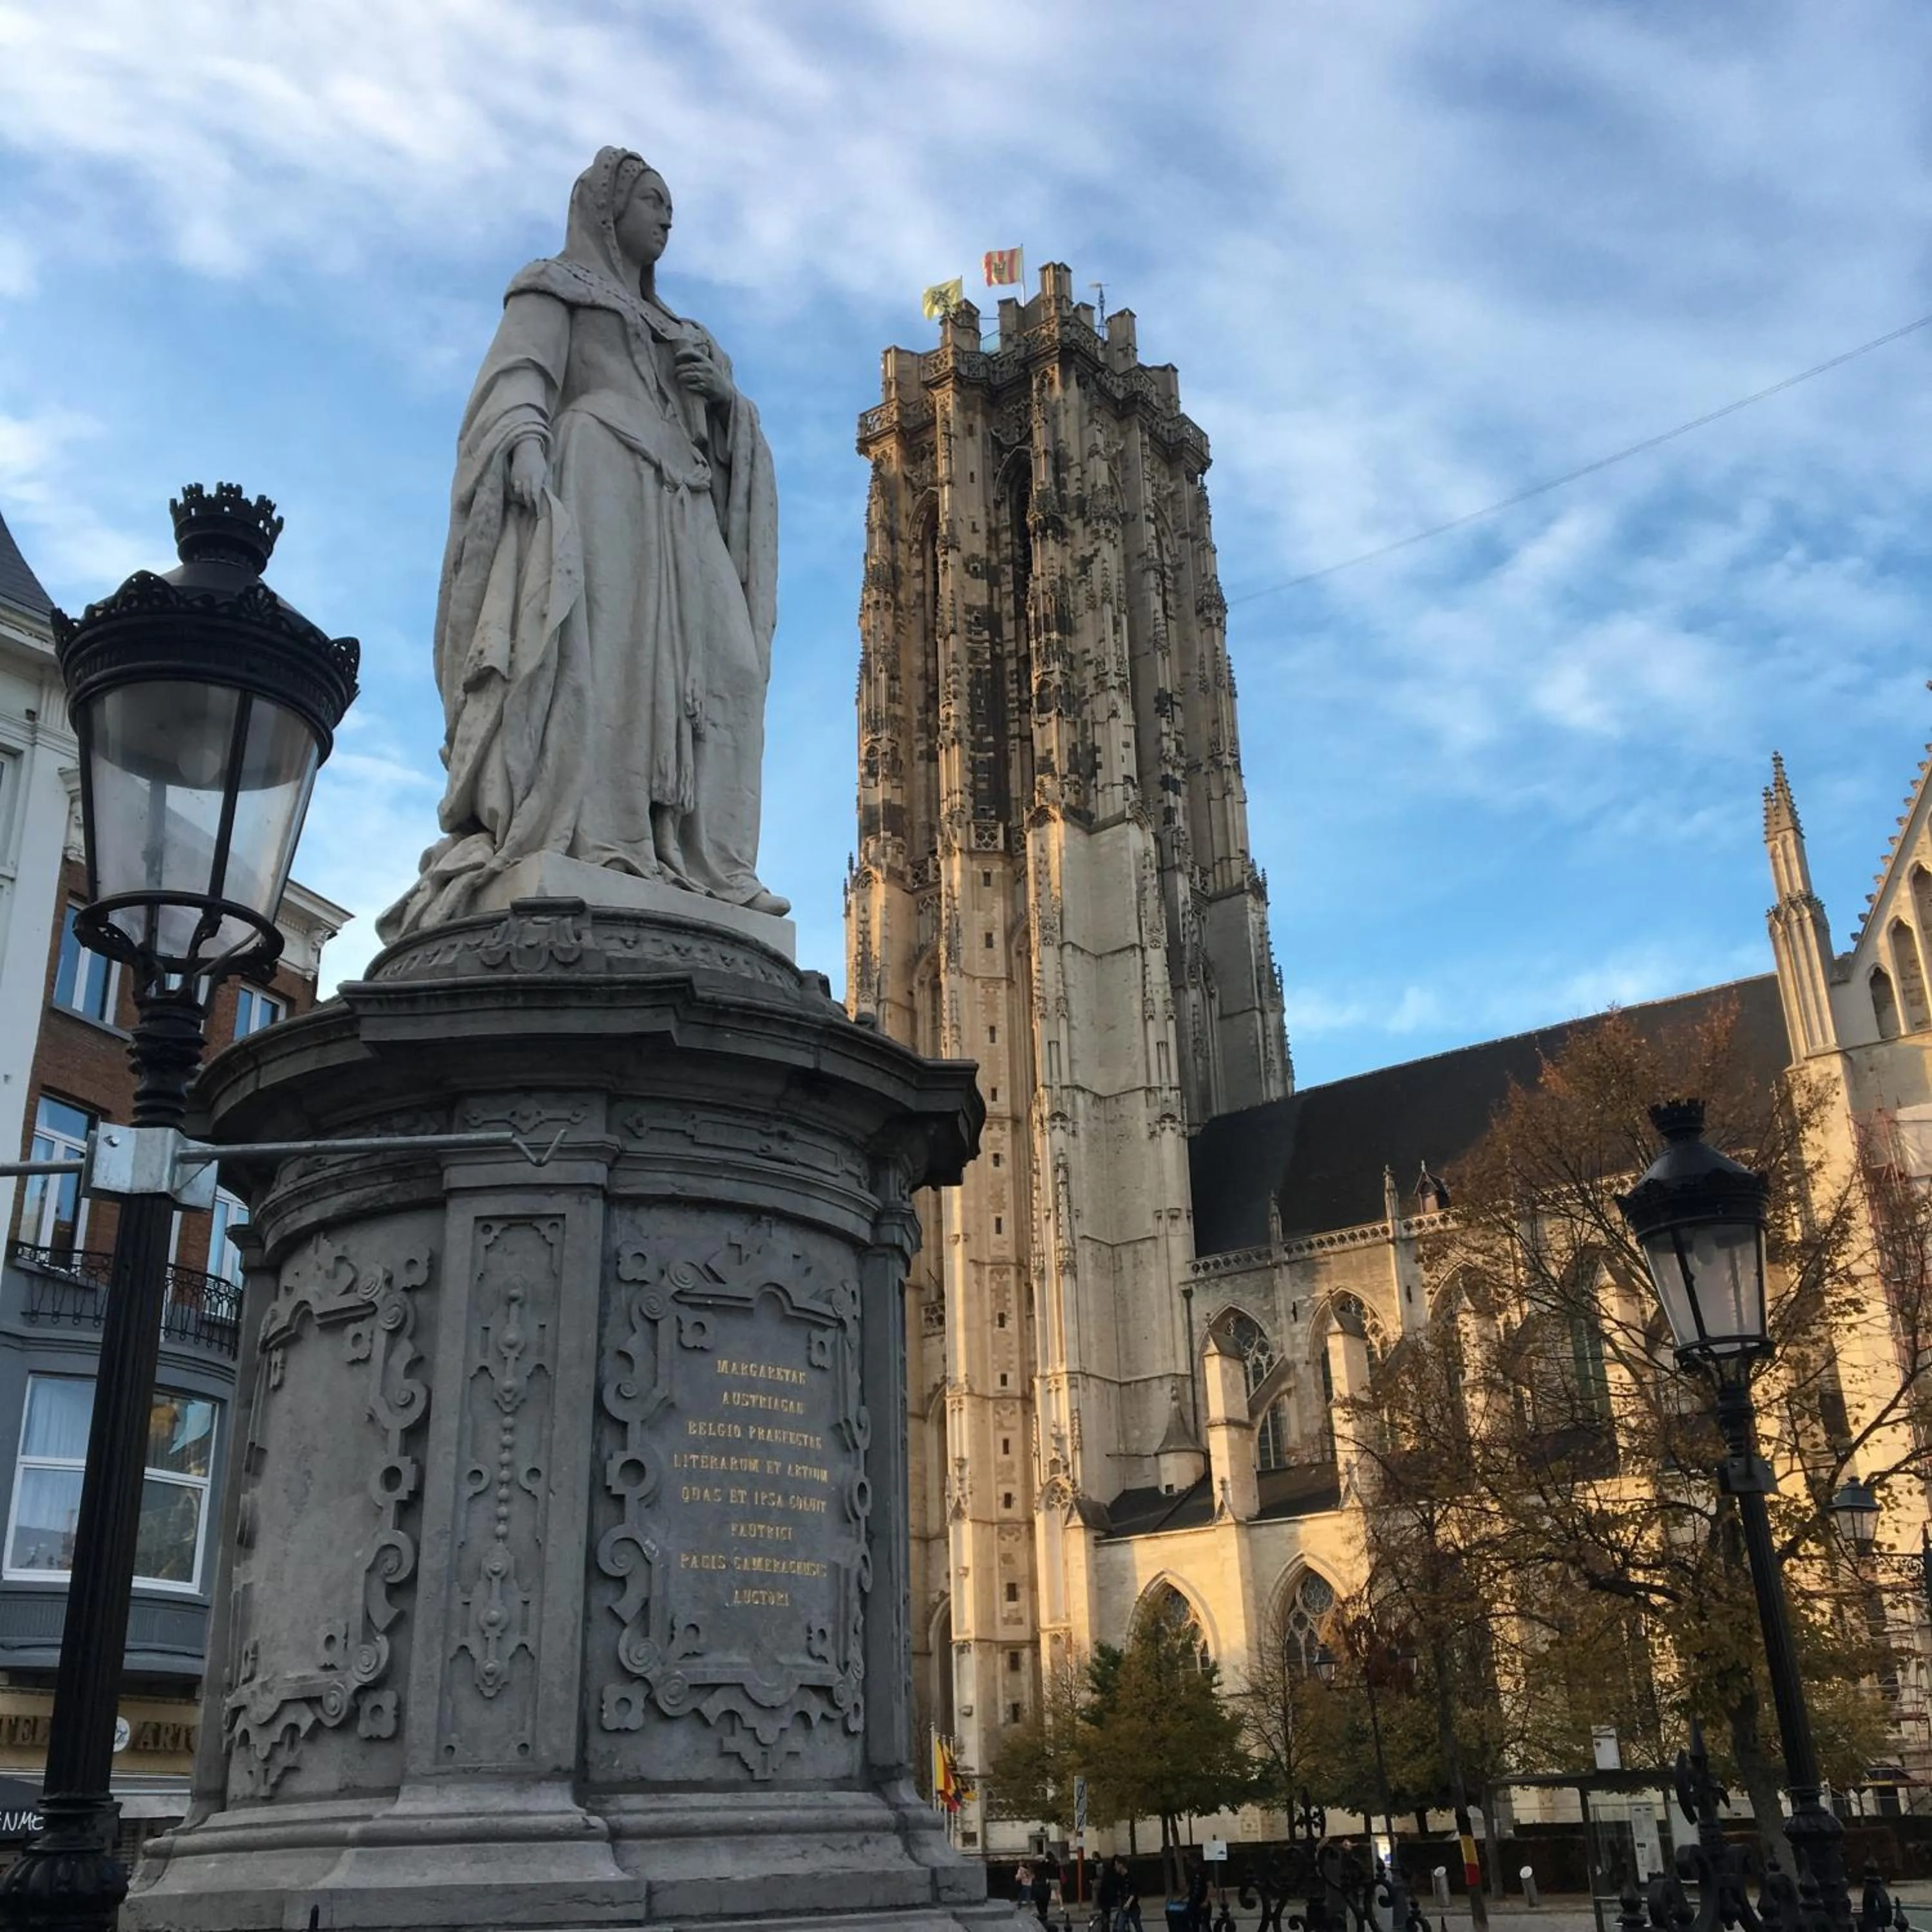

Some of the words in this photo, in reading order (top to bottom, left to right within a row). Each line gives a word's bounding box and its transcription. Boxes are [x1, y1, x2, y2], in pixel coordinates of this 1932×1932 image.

[717, 1359, 806, 1385] MARGARETAE
[688, 1421, 741, 1438] BELGIO
[674, 1454, 759, 1473] LITERARUM
[766, 1460, 781, 1475] ET
[788, 1463, 828, 1482] ARTIUM
[682, 1486, 722, 1502] QUAS
[730, 1488, 747, 1504] ET
[754, 1490, 783, 1508] IPSA
[733, 1589, 790, 1607] AUCTORI
